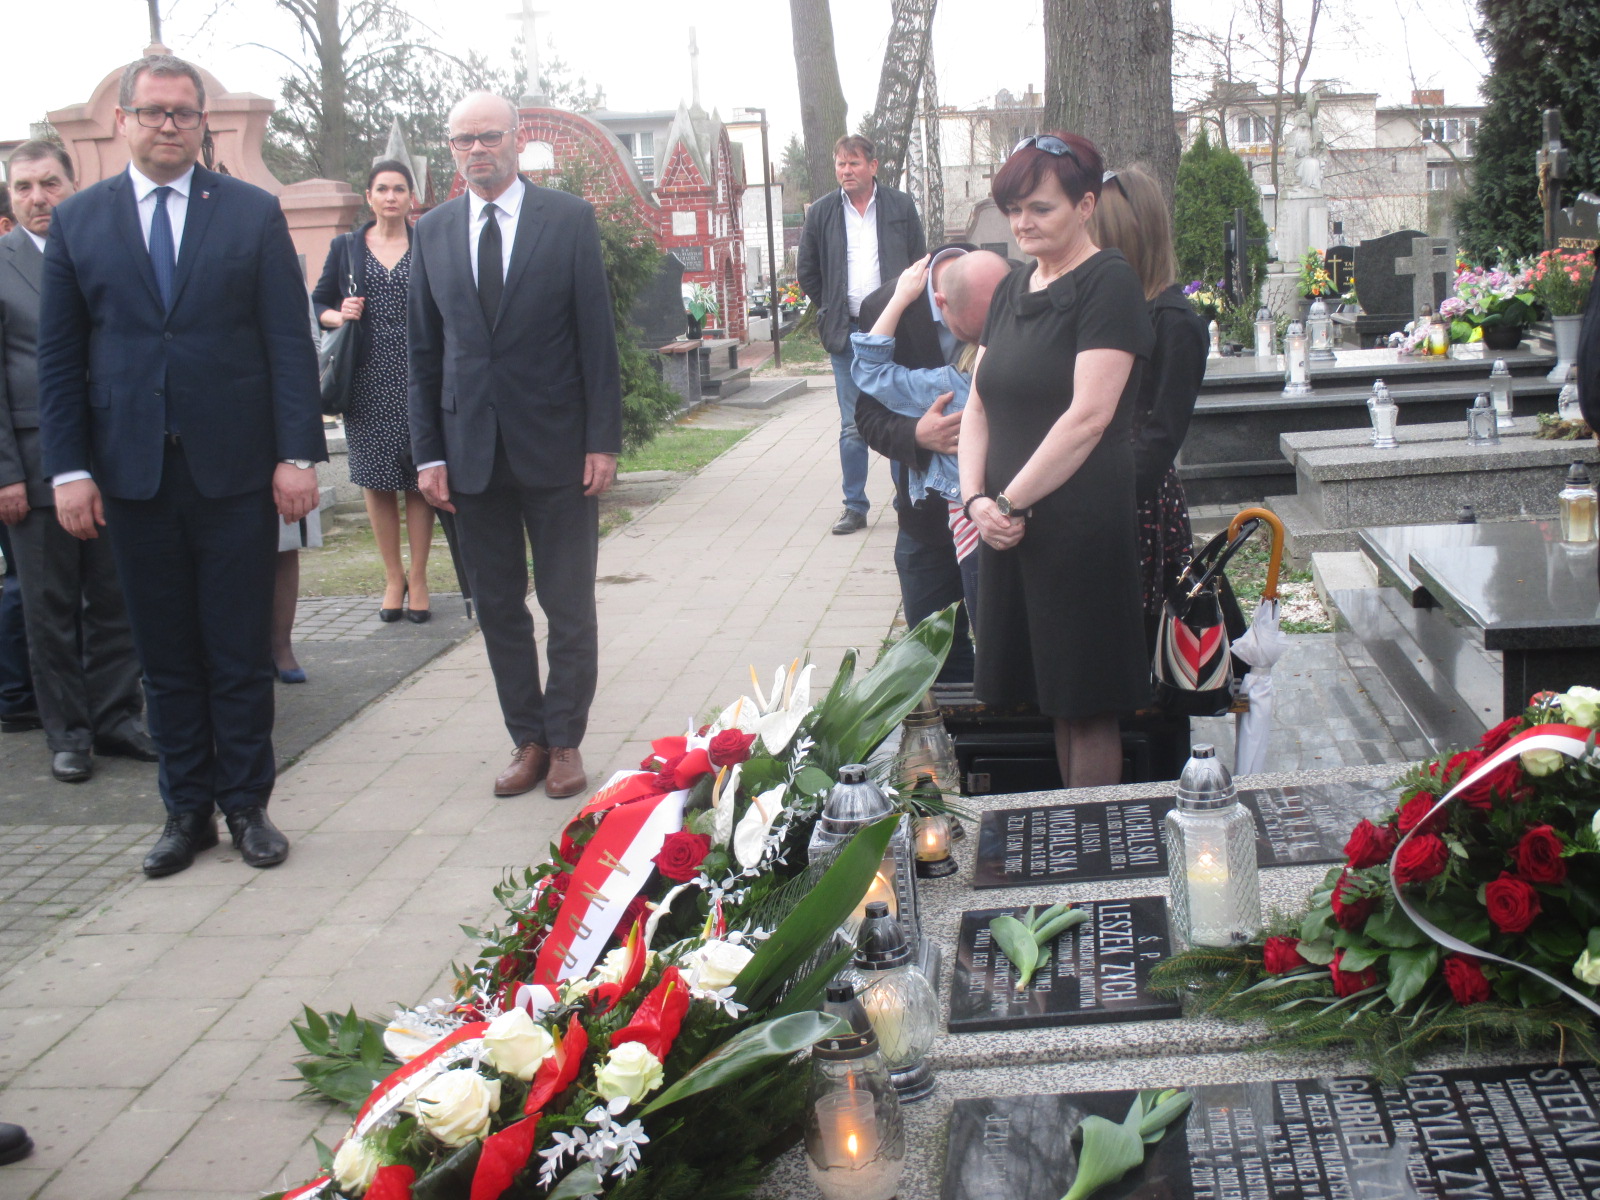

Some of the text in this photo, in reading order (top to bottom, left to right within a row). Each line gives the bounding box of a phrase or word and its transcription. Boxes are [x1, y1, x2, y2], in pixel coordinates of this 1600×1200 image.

[1004, 815, 1026, 874] JEZU UFAM TOBIE
[1049, 809, 1078, 874] MICHALSKA
[1081, 823, 1101, 853] ALUSIA
[1122, 804, 1159, 865] MICHALSKI
[1274, 795, 1321, 850] NOWAK
[972, 952, 988, 968] JEGO
[1079, 935, 1095, 969] WARSZAWSKI
[1099, 904, 1137, 1001] LESZEK ZYCH
[1140, 952, 1160, 961] P.
[1079, 976, 1095, 1008] MOKOTOWA
[1208, 1107, 1233, 1150] LOTNICZEJ
[1277, 1083, 1304, 1119] RODZINY
[1305, 1094, 1332, 1128] PREZES
[1327, 1080, 1394, 1169] GABRIELA
[1392, 1119, 1418, 1137] 1960
[1482, 1082, 1532, 1149] ZAMORDOWANY
[1505, 1078, 1550, 1129] LEGIONISTA
[1533, 1134, 1561, 1155] KPT.
[1529, 1069, 1600, 1147] STEFAN
[1286, 1124, 1321, 1181] KATYŃSKIEJ
[1403, 1075, 1493, 1200] CECYLIA ZY
[1470, 1116, 1500, 1135] 1940
[1498, 1181, 1525, 1198] LAT
[1190, 1167, 1215, 1187] 2010
[1270, 1164, 1295, 1181] 1941
